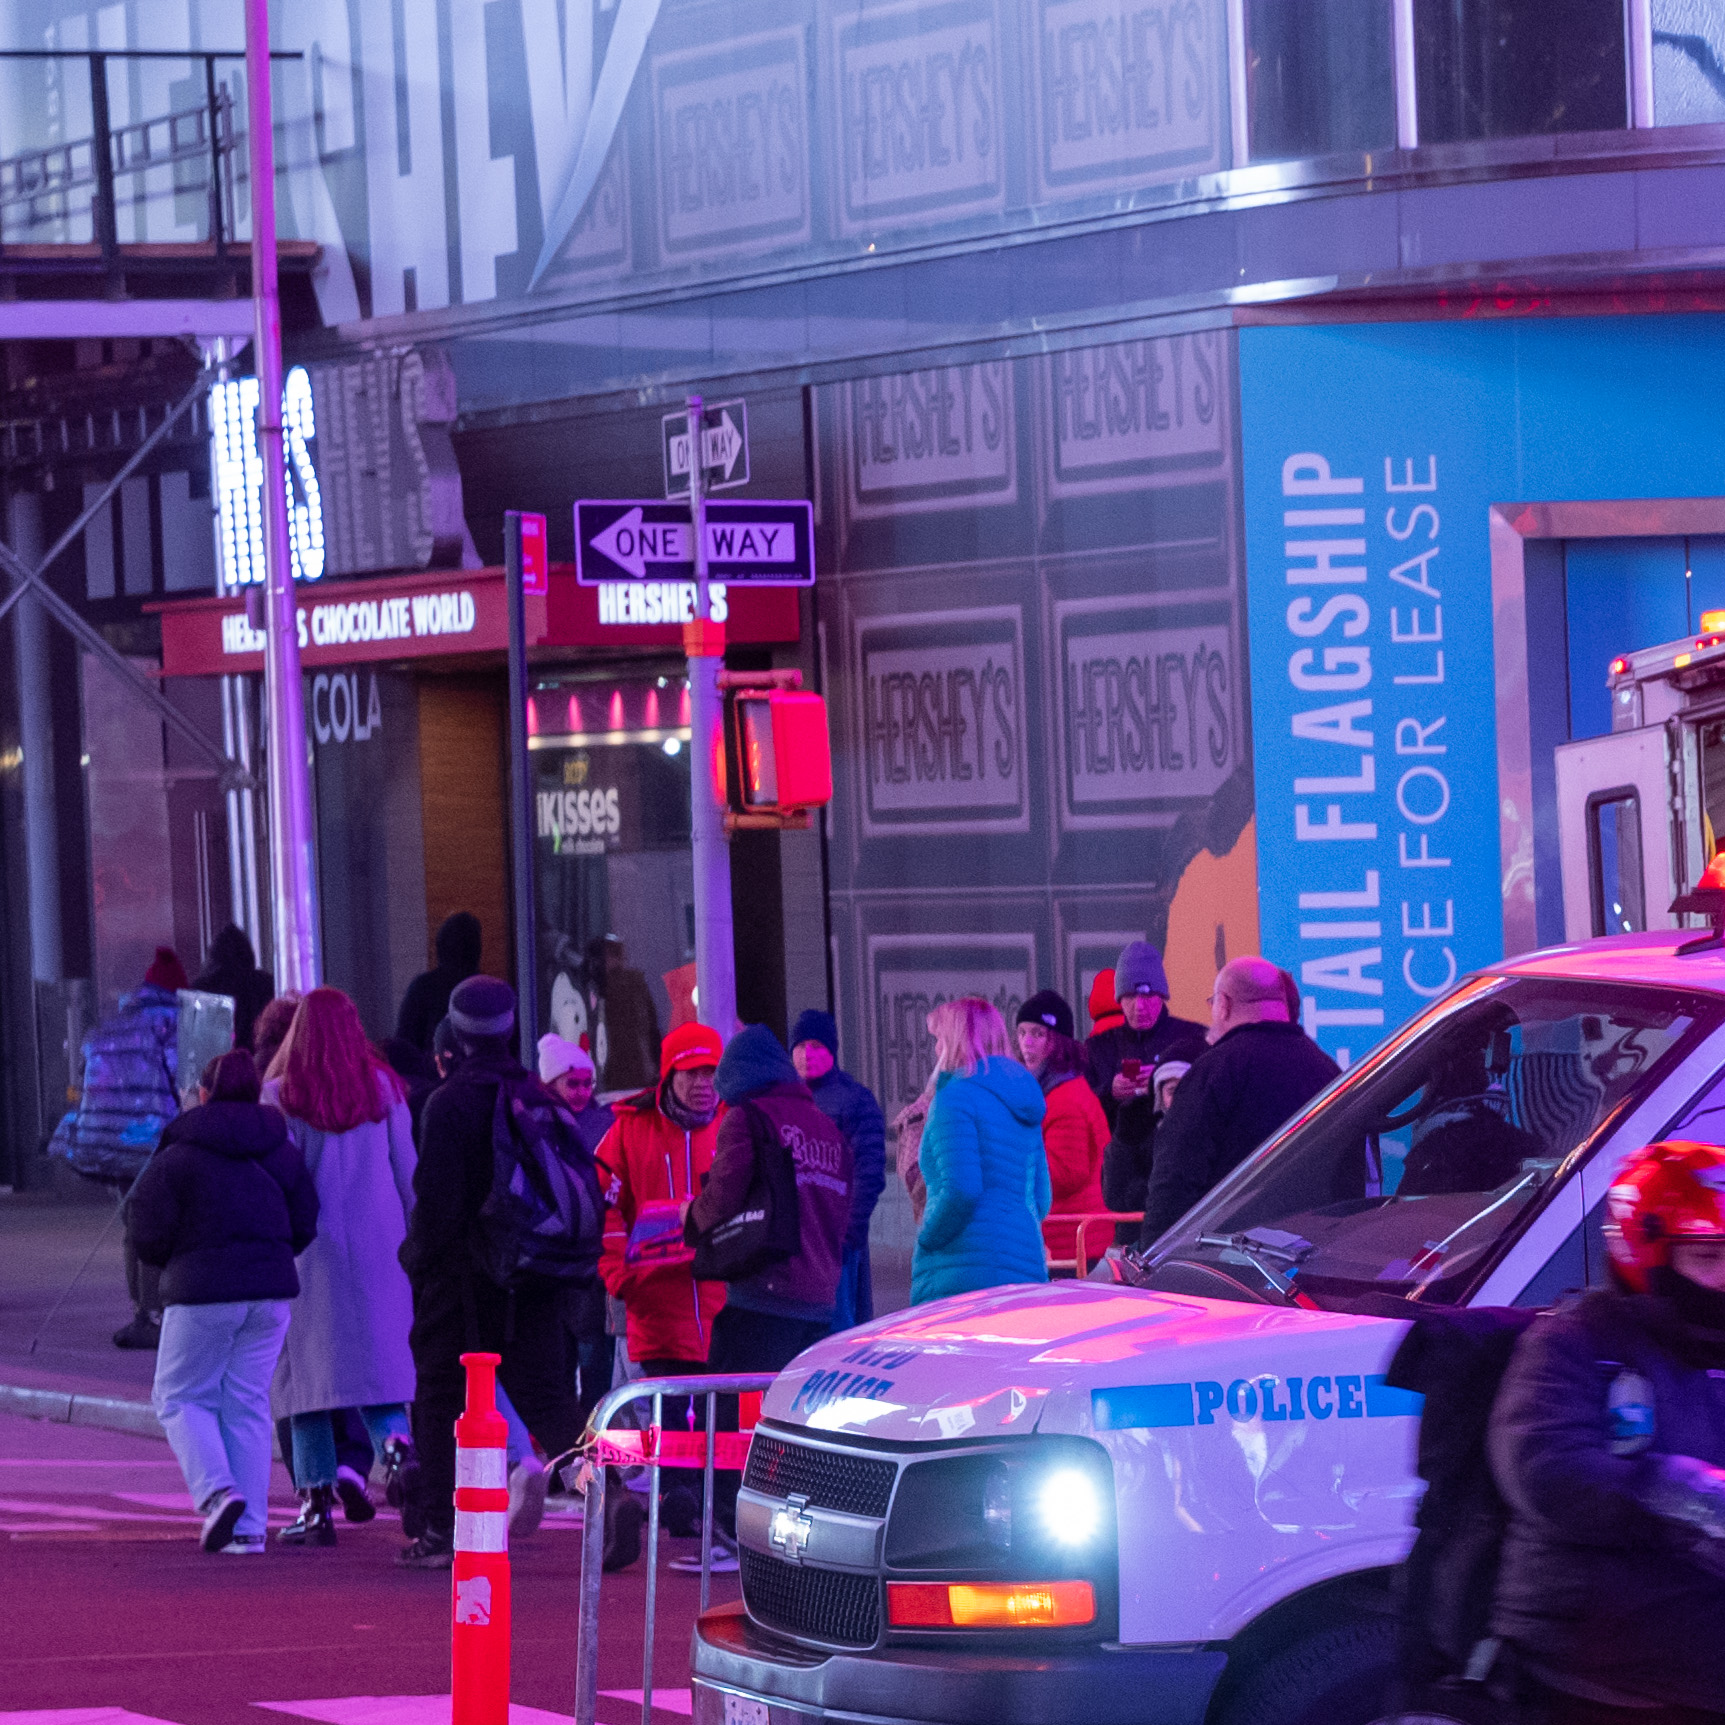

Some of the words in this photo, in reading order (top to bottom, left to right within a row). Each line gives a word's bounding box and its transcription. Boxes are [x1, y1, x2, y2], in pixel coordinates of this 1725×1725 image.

[710, 425, 735, 462] WAY
[857, 360, 1002, 467] HERSHEYS
[1060, 333, 1220, 442] HERSHEYS
[616, 528, 680, 557] ONE
[712, 528, 780, 558] WAY
[1384, 454, 1445, 684] LEASE
[310, 597, 412, 647] CHOCOLATE
[412, 591, 476, 637] WORLD
[1282, 451, 1377, 841] FLAGSHIP
[867, 659, 1015, 786] HERSHEY'S
[1070, 642, 1228, 776] HERSHEY'S
[1395, 715, 1452, 868] FOR
[1298, 869, 1385, 1070] TAIL
[1195, 1375, 1365, 1425] POLICE
